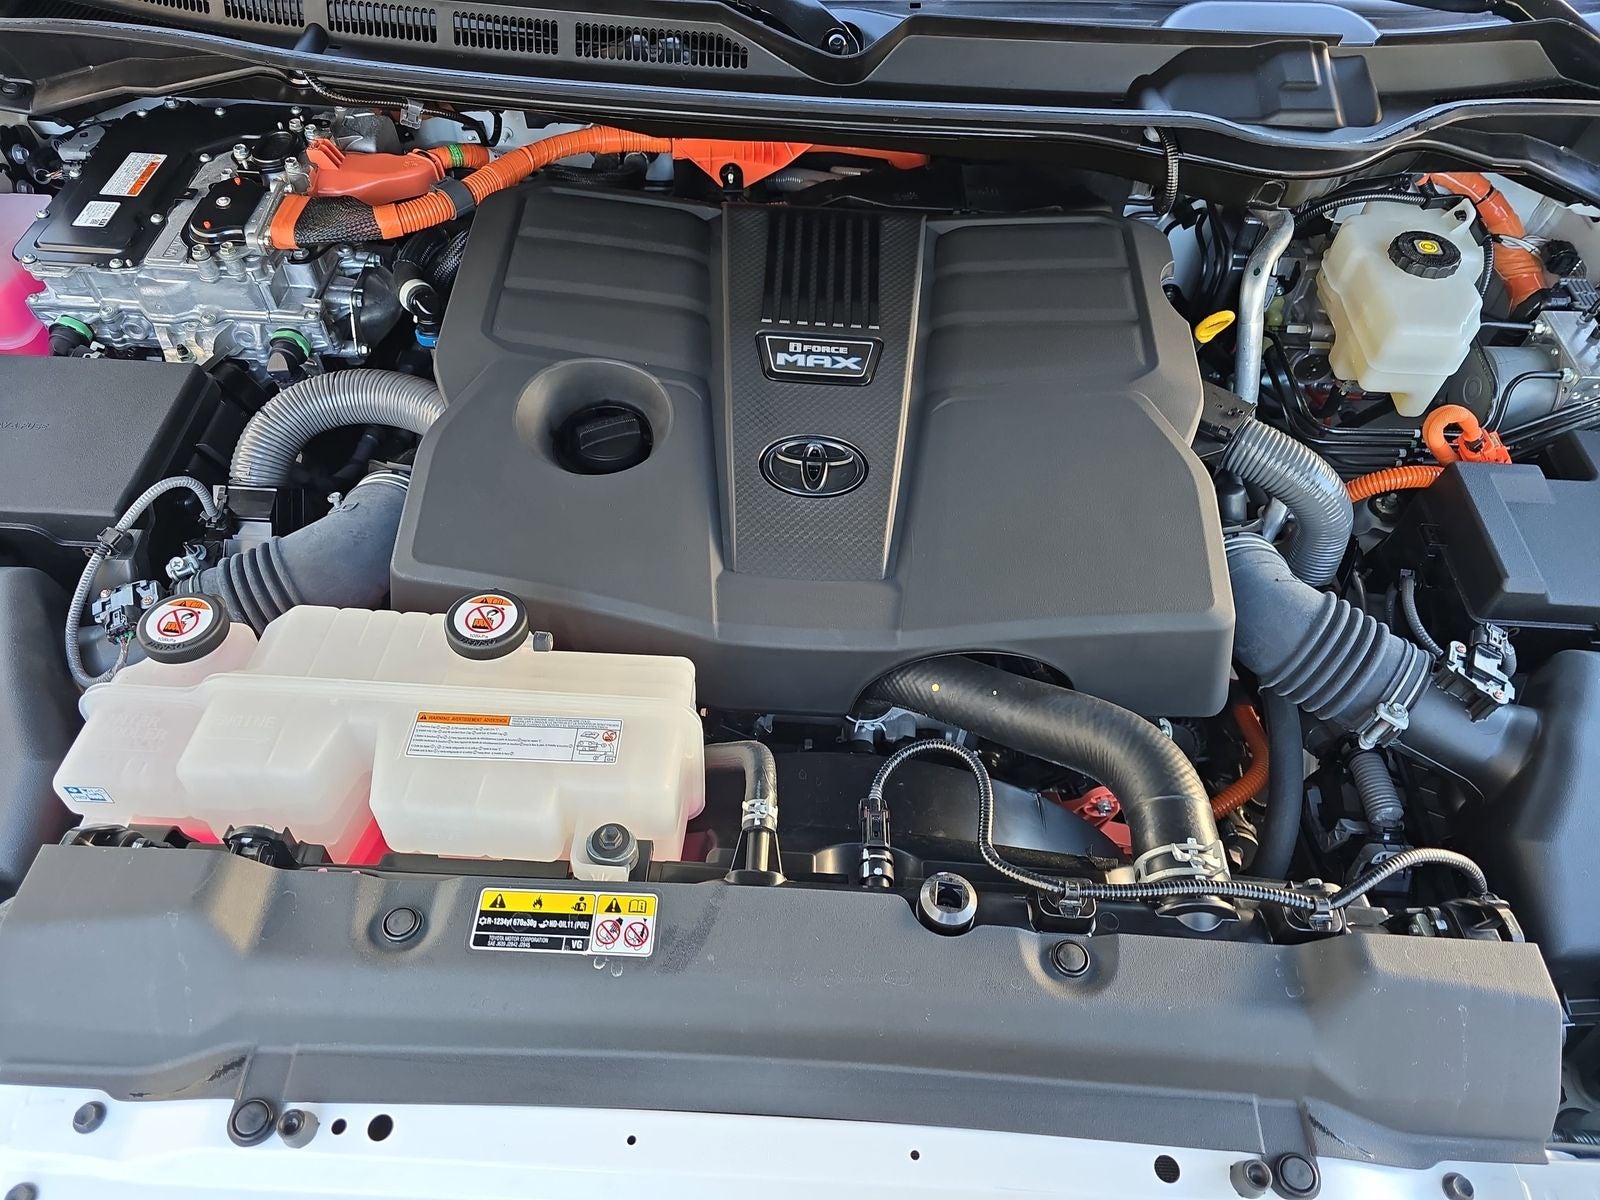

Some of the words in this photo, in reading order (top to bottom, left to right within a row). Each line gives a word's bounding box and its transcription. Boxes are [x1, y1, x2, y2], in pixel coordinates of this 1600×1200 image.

[776, 352, 862, 371] MAX
[520, 936, 549, 944] CORPORATION
[571, 939, 583, 950] VG
